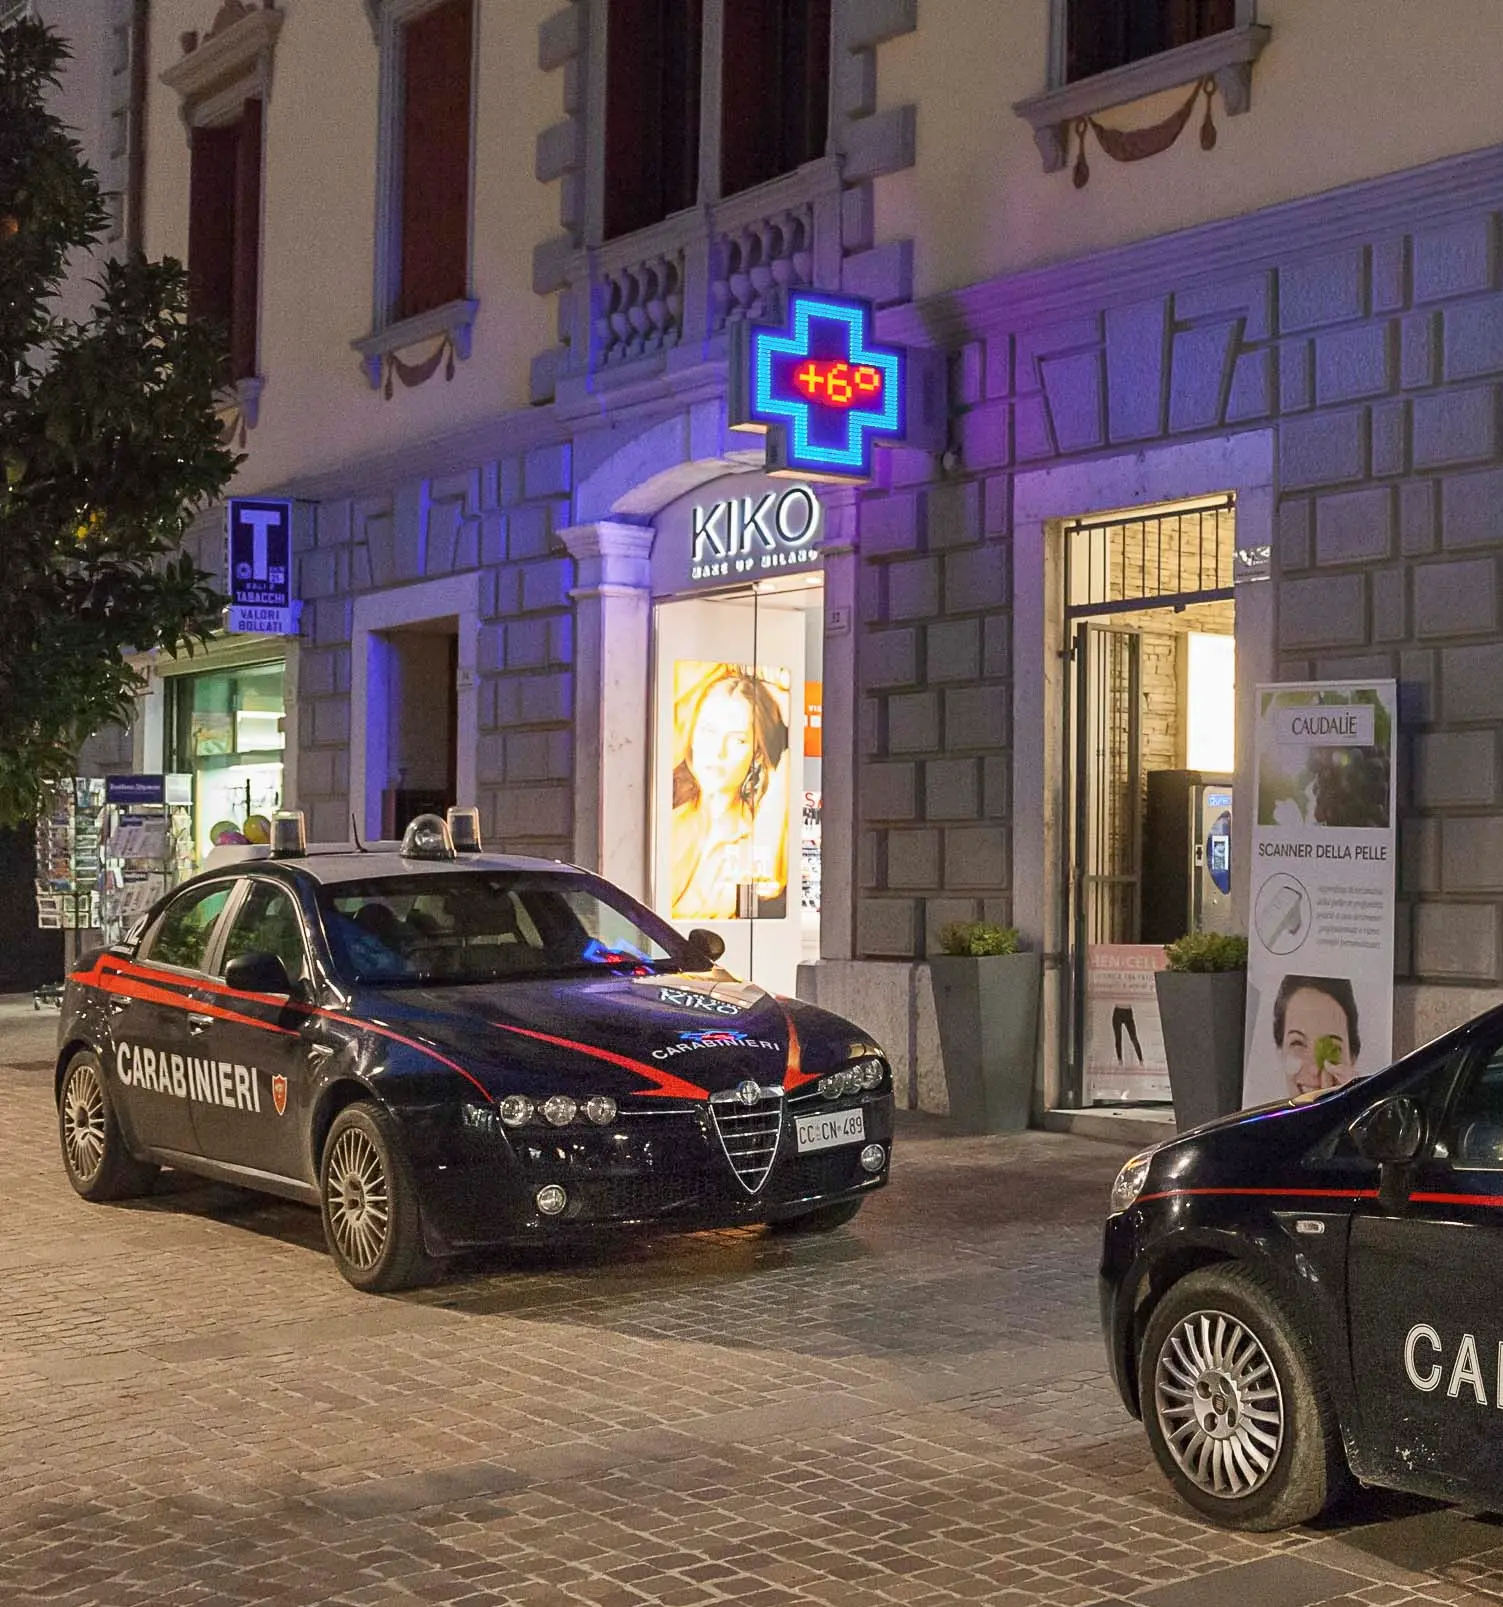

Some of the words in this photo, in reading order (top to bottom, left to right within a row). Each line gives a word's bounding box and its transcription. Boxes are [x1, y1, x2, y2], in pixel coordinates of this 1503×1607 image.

[691, 485, 819, 561] KIKO
[239, 508, 281, 581] T
[735, 558, 755, 573] UP
[240, 608, 280, 621] VALORI
[238, 620, 283, 633] BOLLATI
[1258, 842, 1313, 859] SCANNER
[1316, 844, 1352, 860] DELLA
[1354, 845, 1388, 861] PELLE
[652, 1038, 781, 1061] CARABINIERI
[116, 1041, 261, 1113] CARABINIERI
